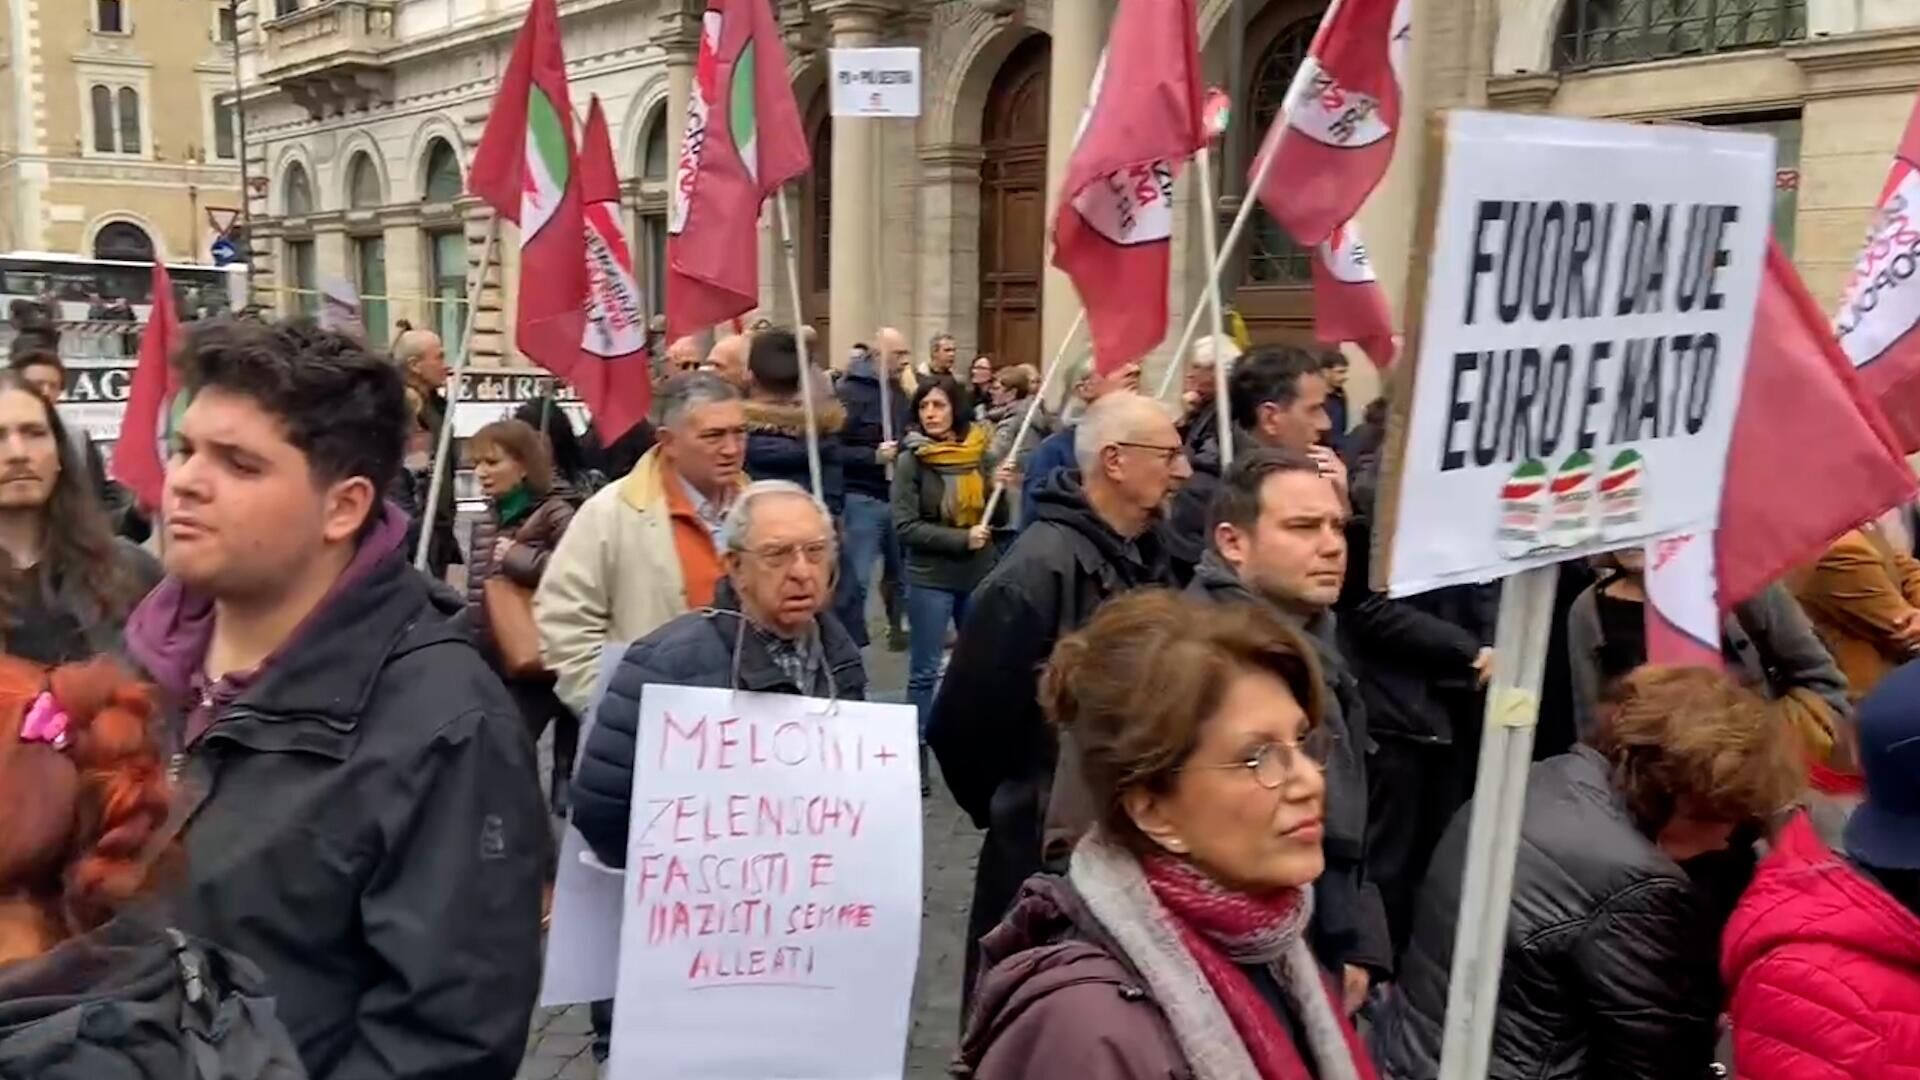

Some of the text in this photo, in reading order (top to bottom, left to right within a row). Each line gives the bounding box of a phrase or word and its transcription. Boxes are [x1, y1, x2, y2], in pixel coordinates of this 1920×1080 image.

[1464, 200, 1615, 325] FUORI
[1615, 202, 1675, 316] DA
[1676, 203, 1741, 313] UE
[1440, 332, 1719, 472] EURO E NATO
[638, 852, 834, 904] FASCISTI E
[688, 945, 815, 979] ALLEATI
